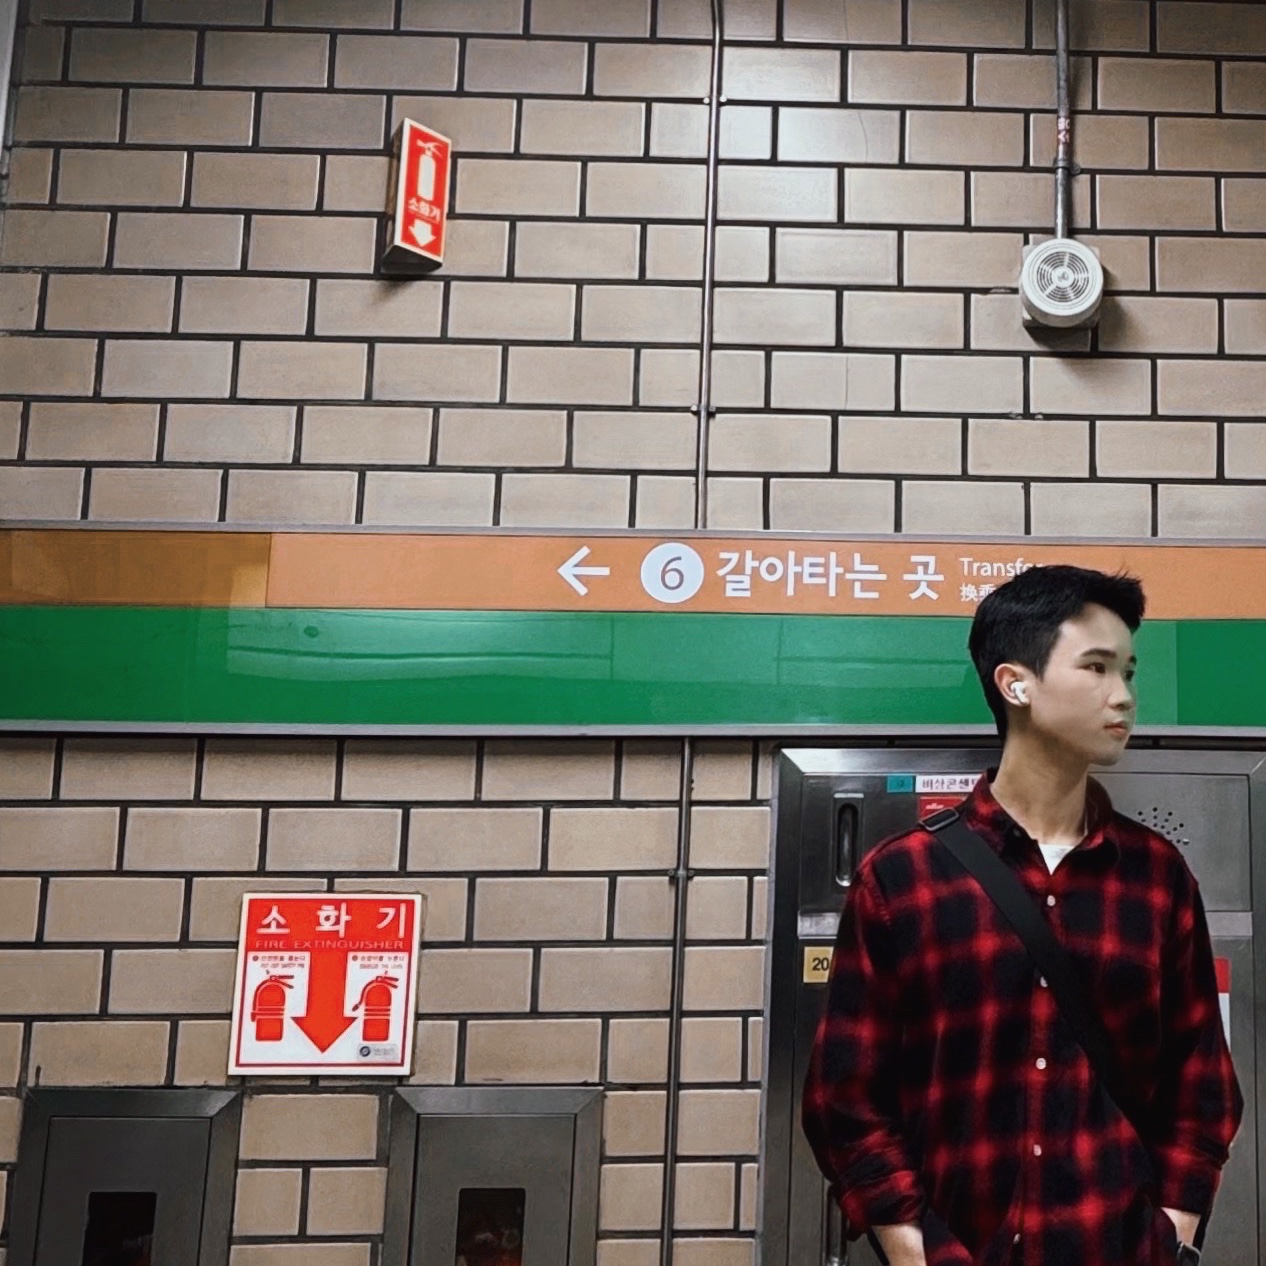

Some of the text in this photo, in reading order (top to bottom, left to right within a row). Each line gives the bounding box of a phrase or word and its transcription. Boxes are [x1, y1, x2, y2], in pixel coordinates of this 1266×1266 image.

[660, 556, 685, 591] 6
[716, 550, 945, 600] 갈아타는 곳
[959, 557, 1042, 577] Transf
[255, 940, 404, 949] FIRE EXTINGUISHER
